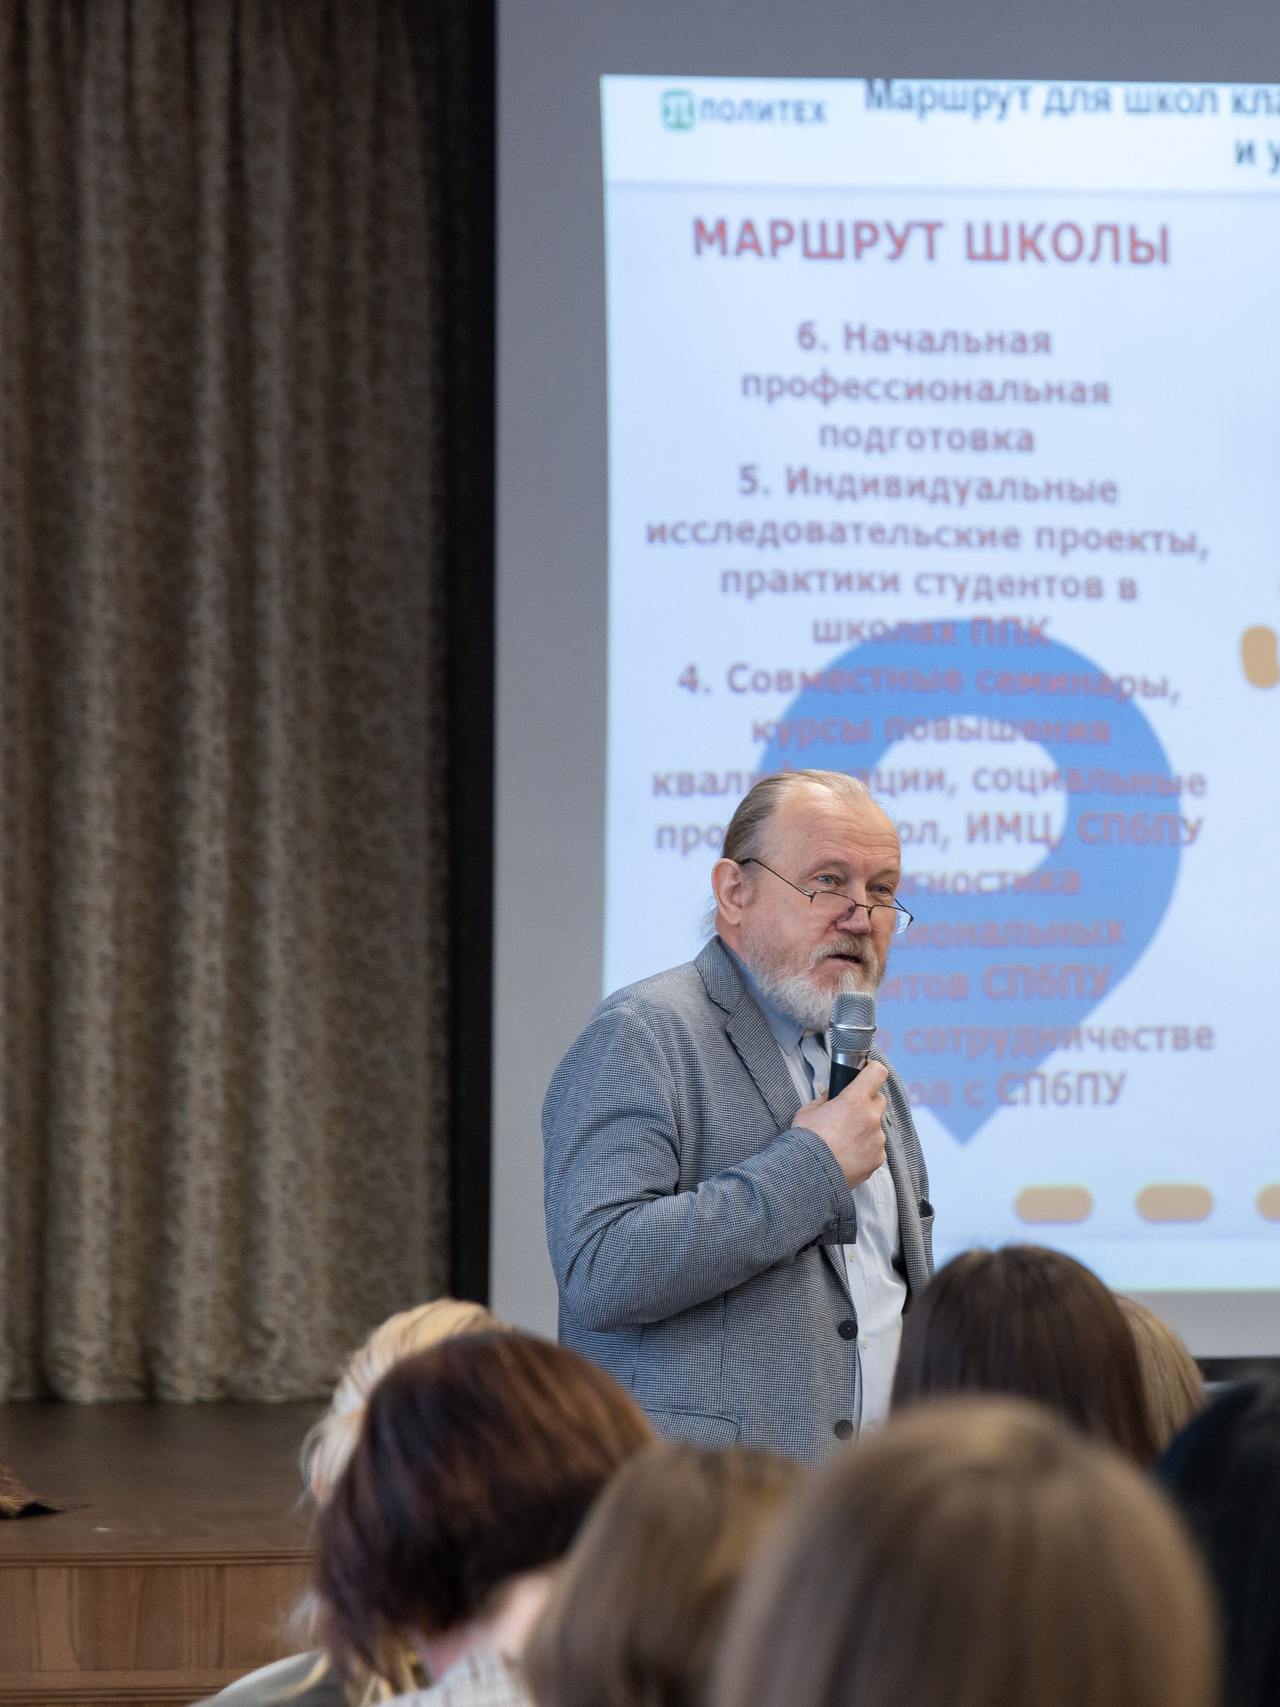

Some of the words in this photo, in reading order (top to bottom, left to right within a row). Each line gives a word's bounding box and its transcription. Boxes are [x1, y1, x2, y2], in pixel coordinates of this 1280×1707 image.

[701, 98, 828, 124] ПОЛИТЕХ
[865, 79, 1031, 119] Маршрут
[1043, 86, 1114, 117] для
[1124, 87, 1219, 115] школ
[1234, 139, 1256, 165] и
[693, 217, 944, 262] МАРШРУТ
[965, 221, 1170, 267] ШКОЛЫ
[796, 321, 830, 353] 6.
[843, 323, 1053, 356] Начальная
[741, 366, 1111, 407] профессиональная
[818, 423, 1036, 455] подготовка
[738, 465, 771, 497] 5.
[785, 466, 1119, 506] Индивидуальные
[646, 519, 1021, 552] исследовательские
[1035, 523, 1209, 562] проекты,
[721, 566, 900, 600] практики
[914, 571, 1103, 602] студентов
[1119, 577, 1140, 602] в
[812, 618, 957, 646] школах
[971, 616, 1051, 648] ППК
[678, 664, 711, 695] 4.
[727, 662, 964, 696] Совместные
[976, 667, 1180, 704] семинары,
[752, 717, 871, 750] курсы
[884, 716, 1112, 746] повышения
[973, 766, 1208, 801] социальные
[966, 812, 1063, 851] ИМЦ,
[1077, 812, 1204, 847] СПбПУ
[982, 962, 1113, 1000] СПбПУ
[904, 1023, 1214, 1061] сотрудничестве
[964, 1079, 985, 1108] с
[998, 1070, 1126, 1107] СПбПУ
